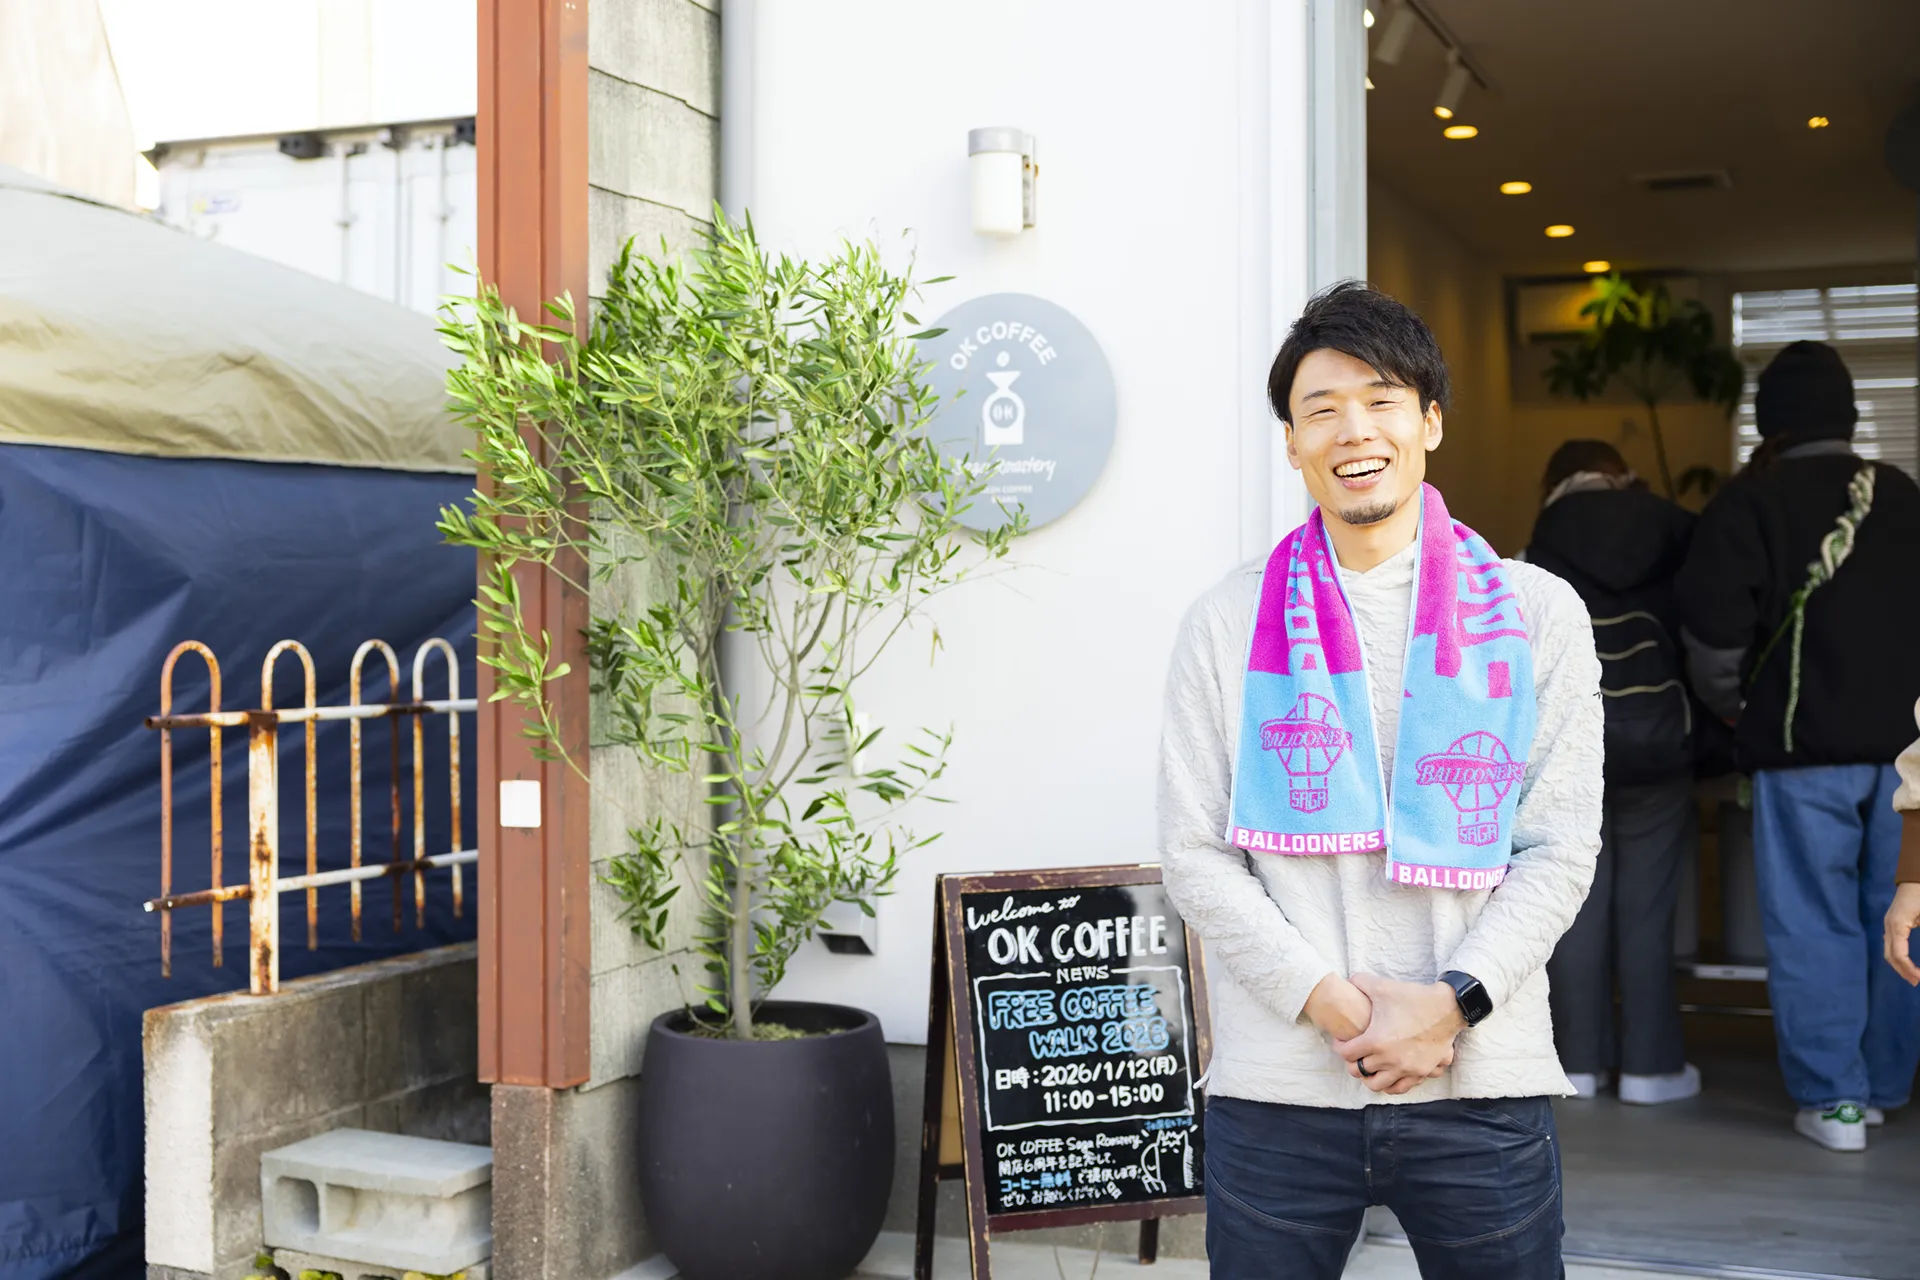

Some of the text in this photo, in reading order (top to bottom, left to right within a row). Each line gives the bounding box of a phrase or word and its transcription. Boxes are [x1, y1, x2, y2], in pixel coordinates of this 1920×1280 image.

[950, 320, 1057, 370] OK COFFEE
[992, 404, 1014, 421] OK
[1291, 790, 1327, 811] SAGA
[1237, 828, 1380, 853] BALLOONERS
[1459, 825, 1497, 843] SAGA
[987, 916, 1168, 965] OK COFFEE
[1056, 965, 1110, 984] NEWS
[988, 984, 1158, 1030] FREE COFFEE
[1028, 1016, 1170, 1060] WALK 2026
[1043, 1083, 1164, 1114] 11:00-15:00
[996, 1142, 1016, 1157] OK
[1020, 1137, 1065, 1155] COFFEE
